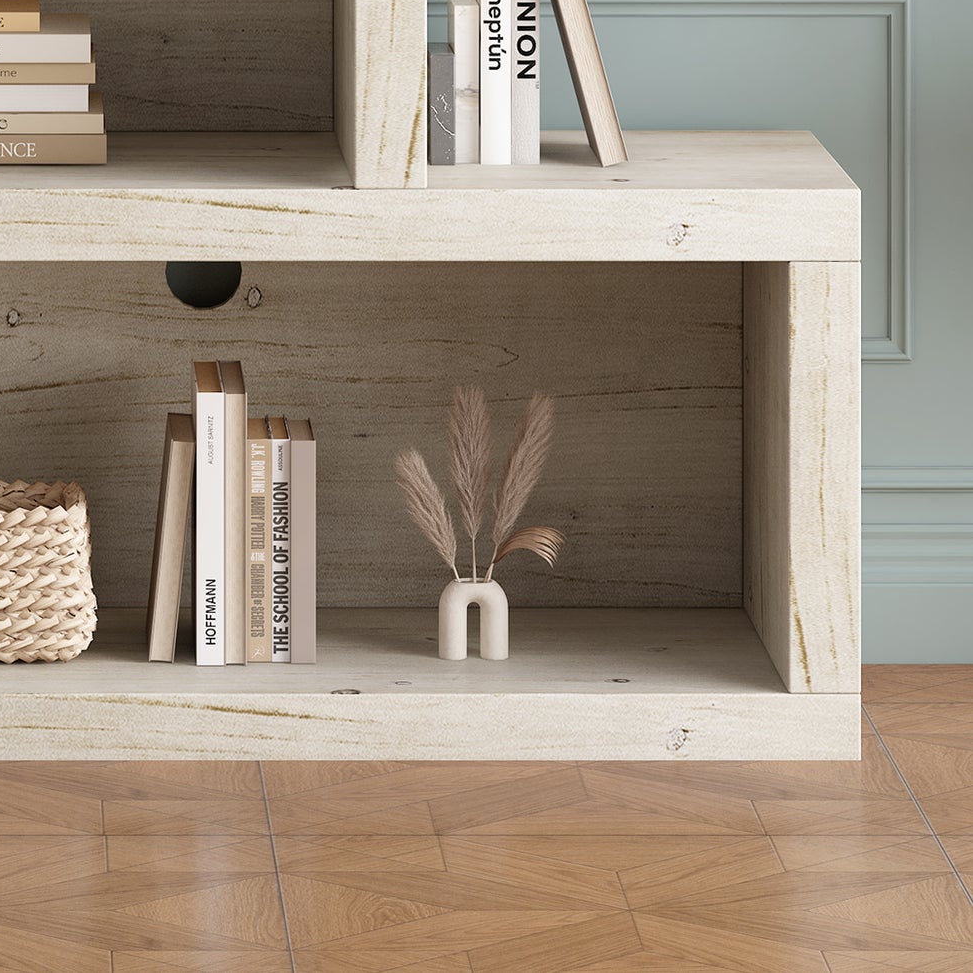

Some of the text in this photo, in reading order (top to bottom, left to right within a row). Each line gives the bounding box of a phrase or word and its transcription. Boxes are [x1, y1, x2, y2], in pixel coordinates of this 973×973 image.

[250, 443, 266, 459] J.K.
[250, 460, 266, 493] ROWLING
[250, 496, 266, 521] HARRY
[250, 522, 266, 550] POTTER
[250, 563, 266, 599] CHAMBER
[273, 481, 289, 655] THE SCHOOL OF FASHION
[205, 578, 217, 646] HOFFMANN
[250, 606, 266, 638] SECRETS
